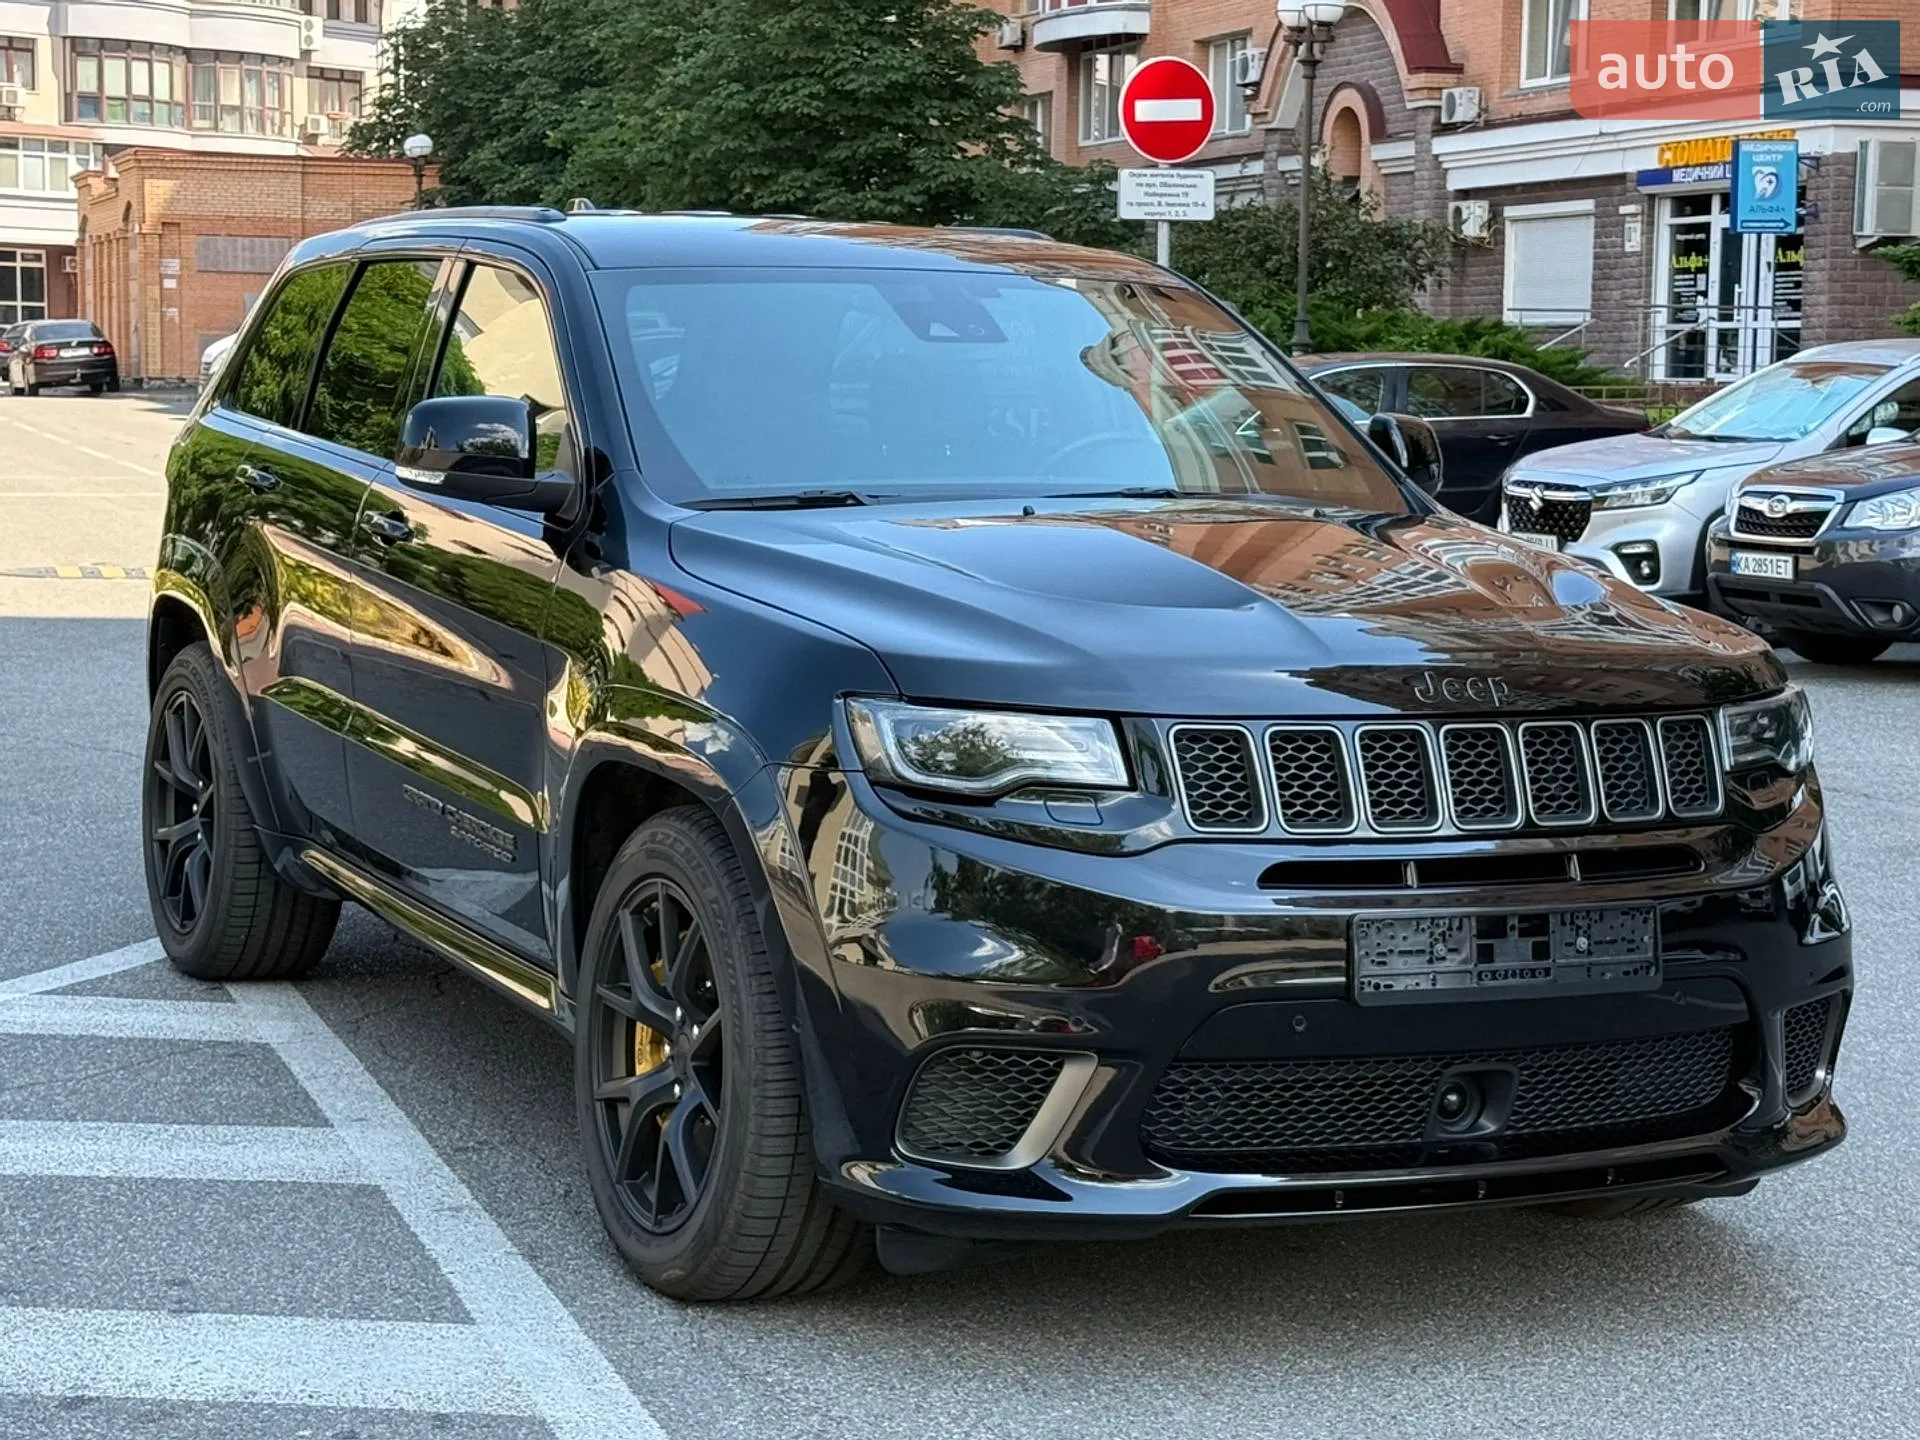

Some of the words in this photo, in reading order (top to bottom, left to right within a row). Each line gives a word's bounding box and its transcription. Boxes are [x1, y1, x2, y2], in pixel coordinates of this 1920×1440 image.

[1752, 153, 1784, 163] ЦЕНТР
[1671, 162, 1725, 184] МЕДИЧНИЙ
[1749, 204, 1786, 213] АЛЬФА+
[1413, 670, 1508, 708] Jeep
